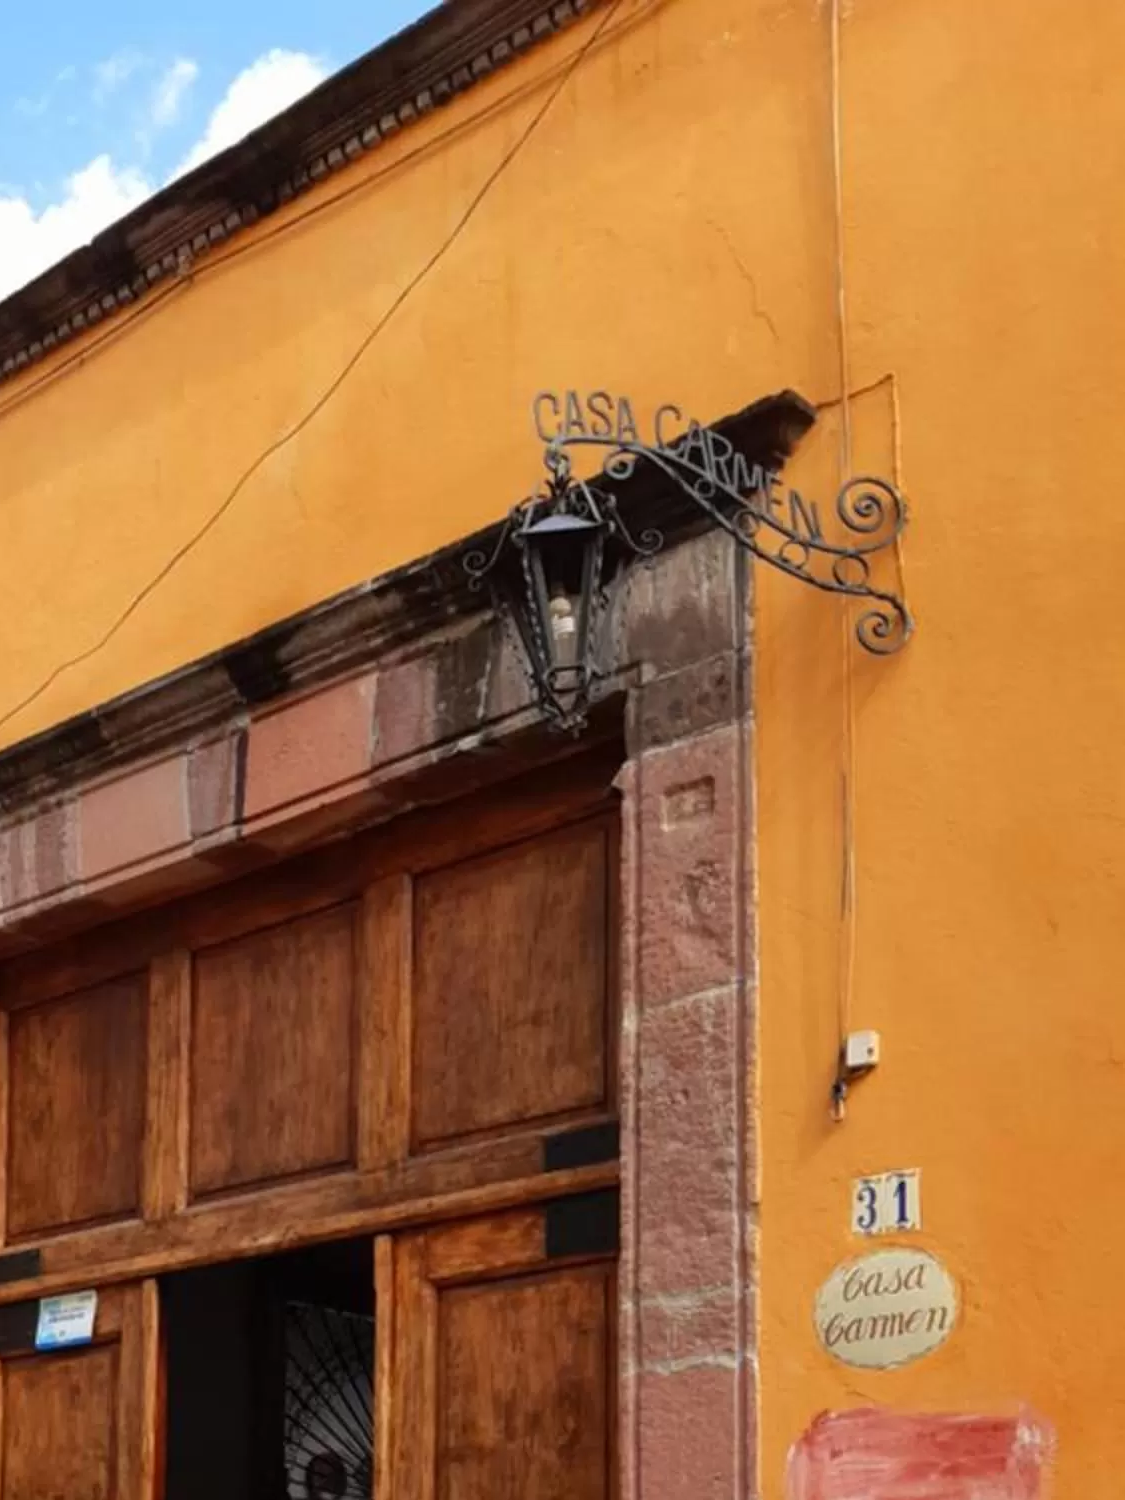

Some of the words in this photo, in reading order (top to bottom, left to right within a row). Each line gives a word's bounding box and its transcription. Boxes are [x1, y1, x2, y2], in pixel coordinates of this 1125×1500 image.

[532, 390, 639, 443] CASA
[654, 405, 824, 544] CARMEN
[856, 1179, 909, 1230] 31
[842, 1263, 926, 1303] Casa
[824, 1305, 948, 1348] Carmen
